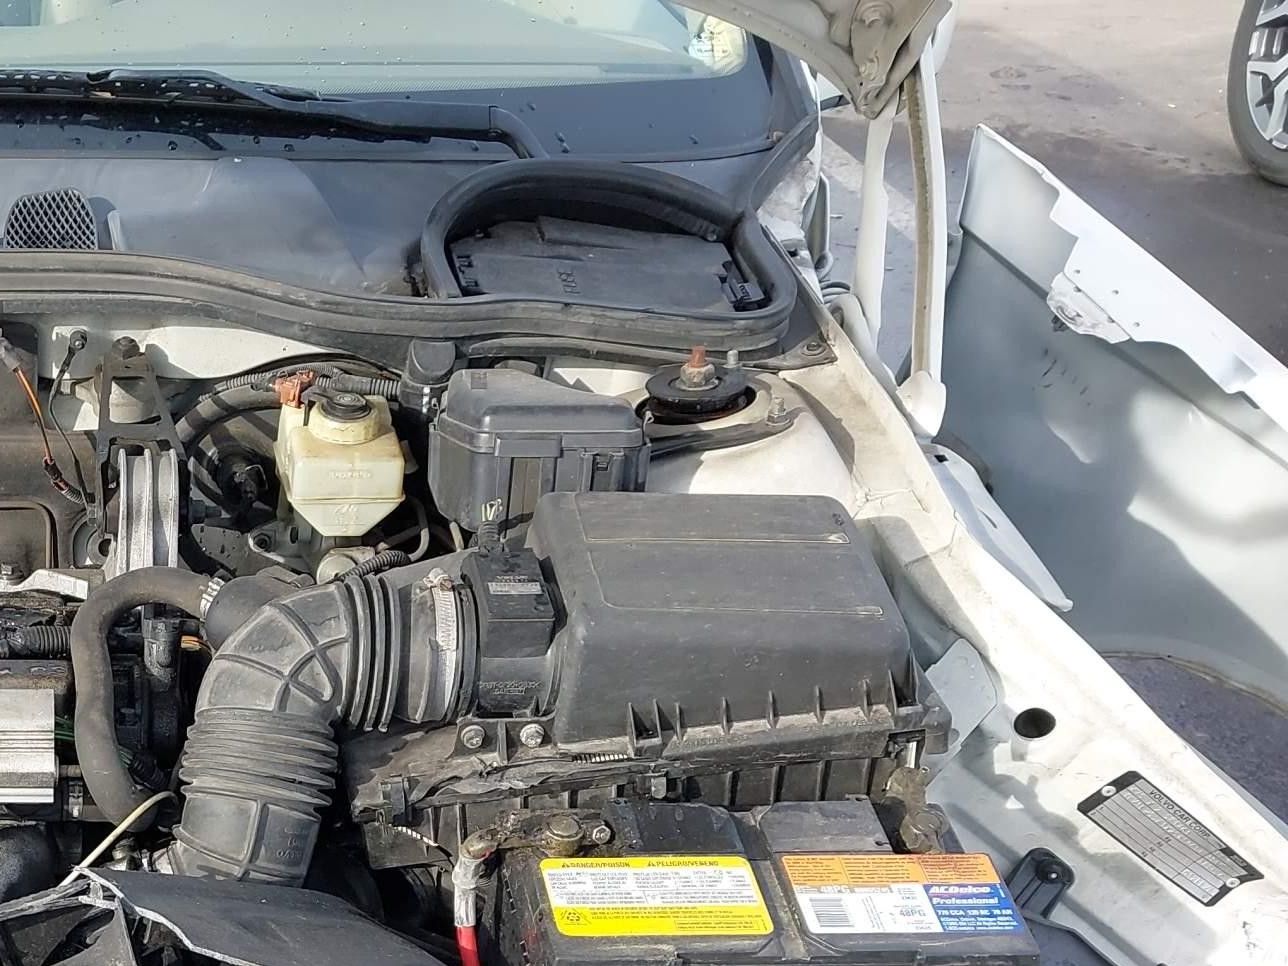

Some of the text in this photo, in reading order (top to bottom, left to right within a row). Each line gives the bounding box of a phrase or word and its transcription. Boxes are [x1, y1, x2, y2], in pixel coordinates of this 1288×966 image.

[1149, 789, 1175, 812] VOLVO
[1173, 808, 1192, 824] CAR
[928, 885, 991, 894] ACDelco
[932, 897, 999, 905] Professional
[898, 908, 927, 917] 48PG
